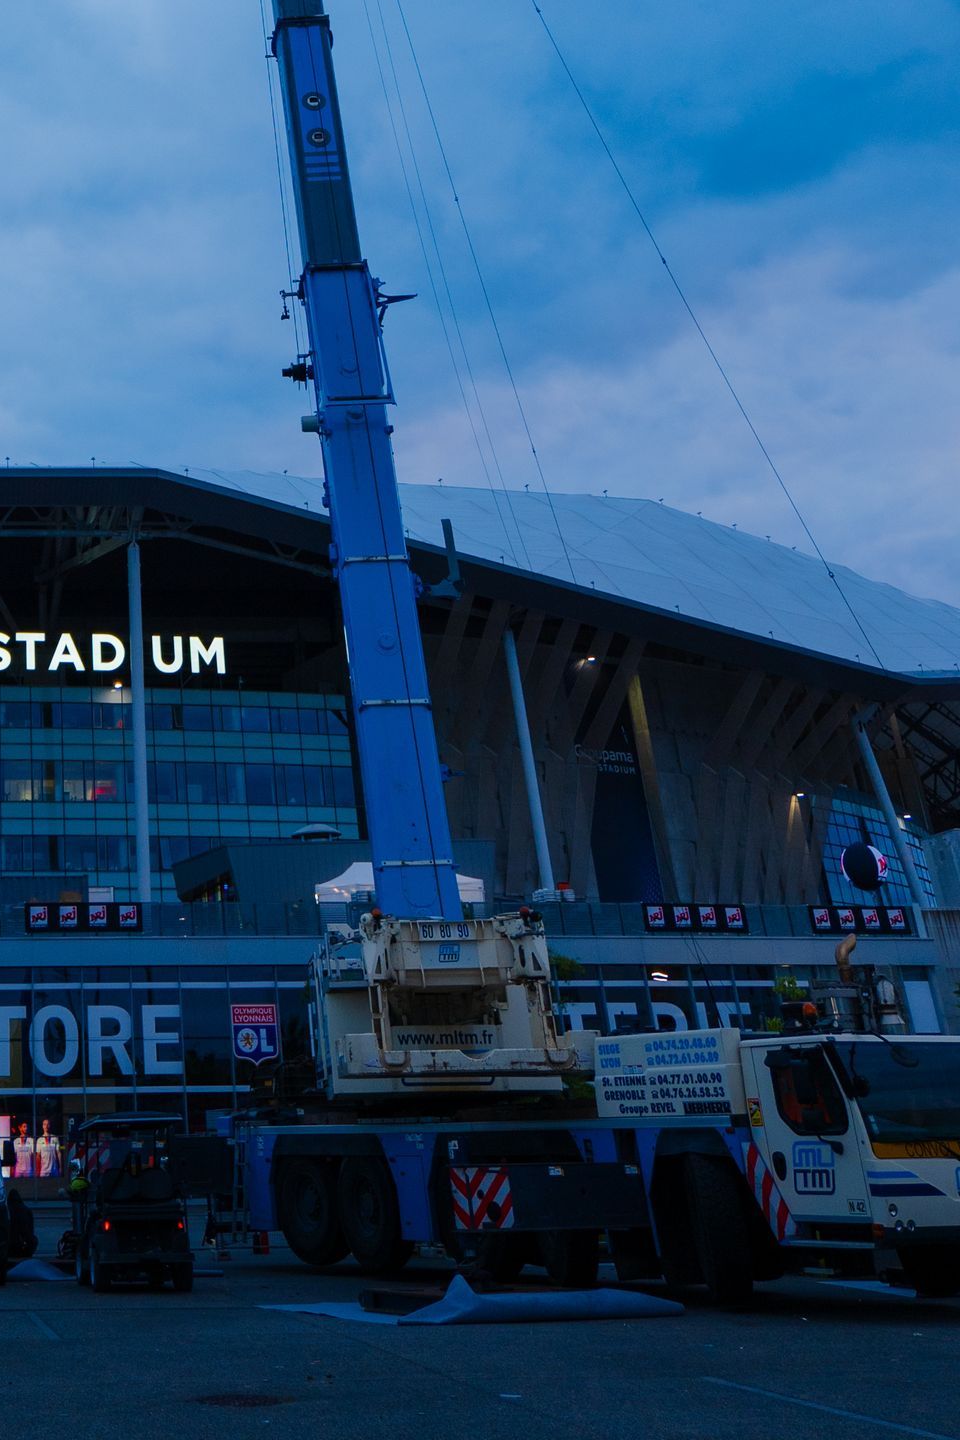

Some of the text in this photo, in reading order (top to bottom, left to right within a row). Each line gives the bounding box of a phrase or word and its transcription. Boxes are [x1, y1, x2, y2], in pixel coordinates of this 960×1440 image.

[422, 923, 469, 938] 60 80 90
[397, 1030, 493, 1045] www.mltm.fr
[598, 1044, 620, 1055] SIEGE
[600, 1057, 621, 1068] LYON
[614, 1076, 647, 1086] ETIENNE
[657, 1072, 722, 1084] 04.77.01.00.90
[604, 1090, 646, 1101] GRENOBLE
[619, 1101, 732, 1116] Groupe REVEL LIEBHERR
